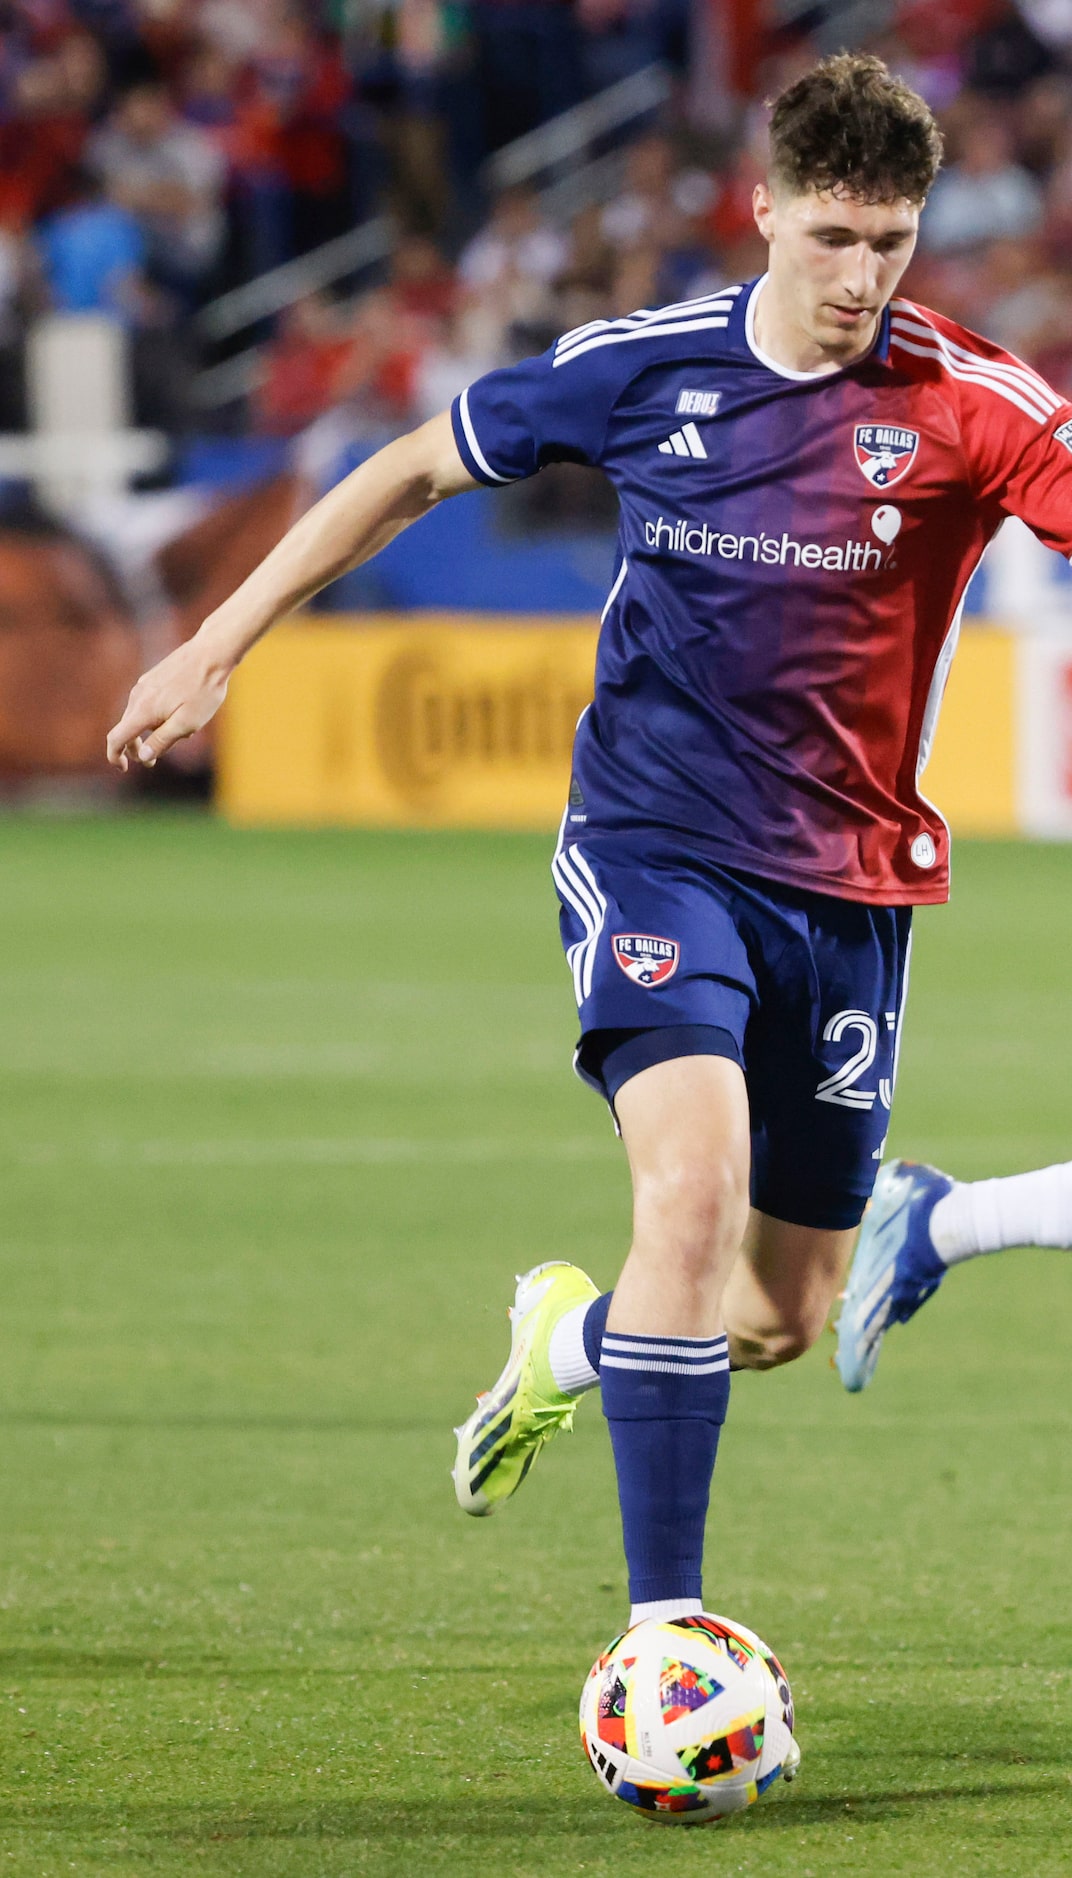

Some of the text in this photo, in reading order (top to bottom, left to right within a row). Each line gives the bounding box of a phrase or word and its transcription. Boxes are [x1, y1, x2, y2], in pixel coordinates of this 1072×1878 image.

[678, 390, 720, 414] DEBUT
[859, 428, 914, 449] FC DALLAS
[619, 938, 673, 958] FC DALLAS
